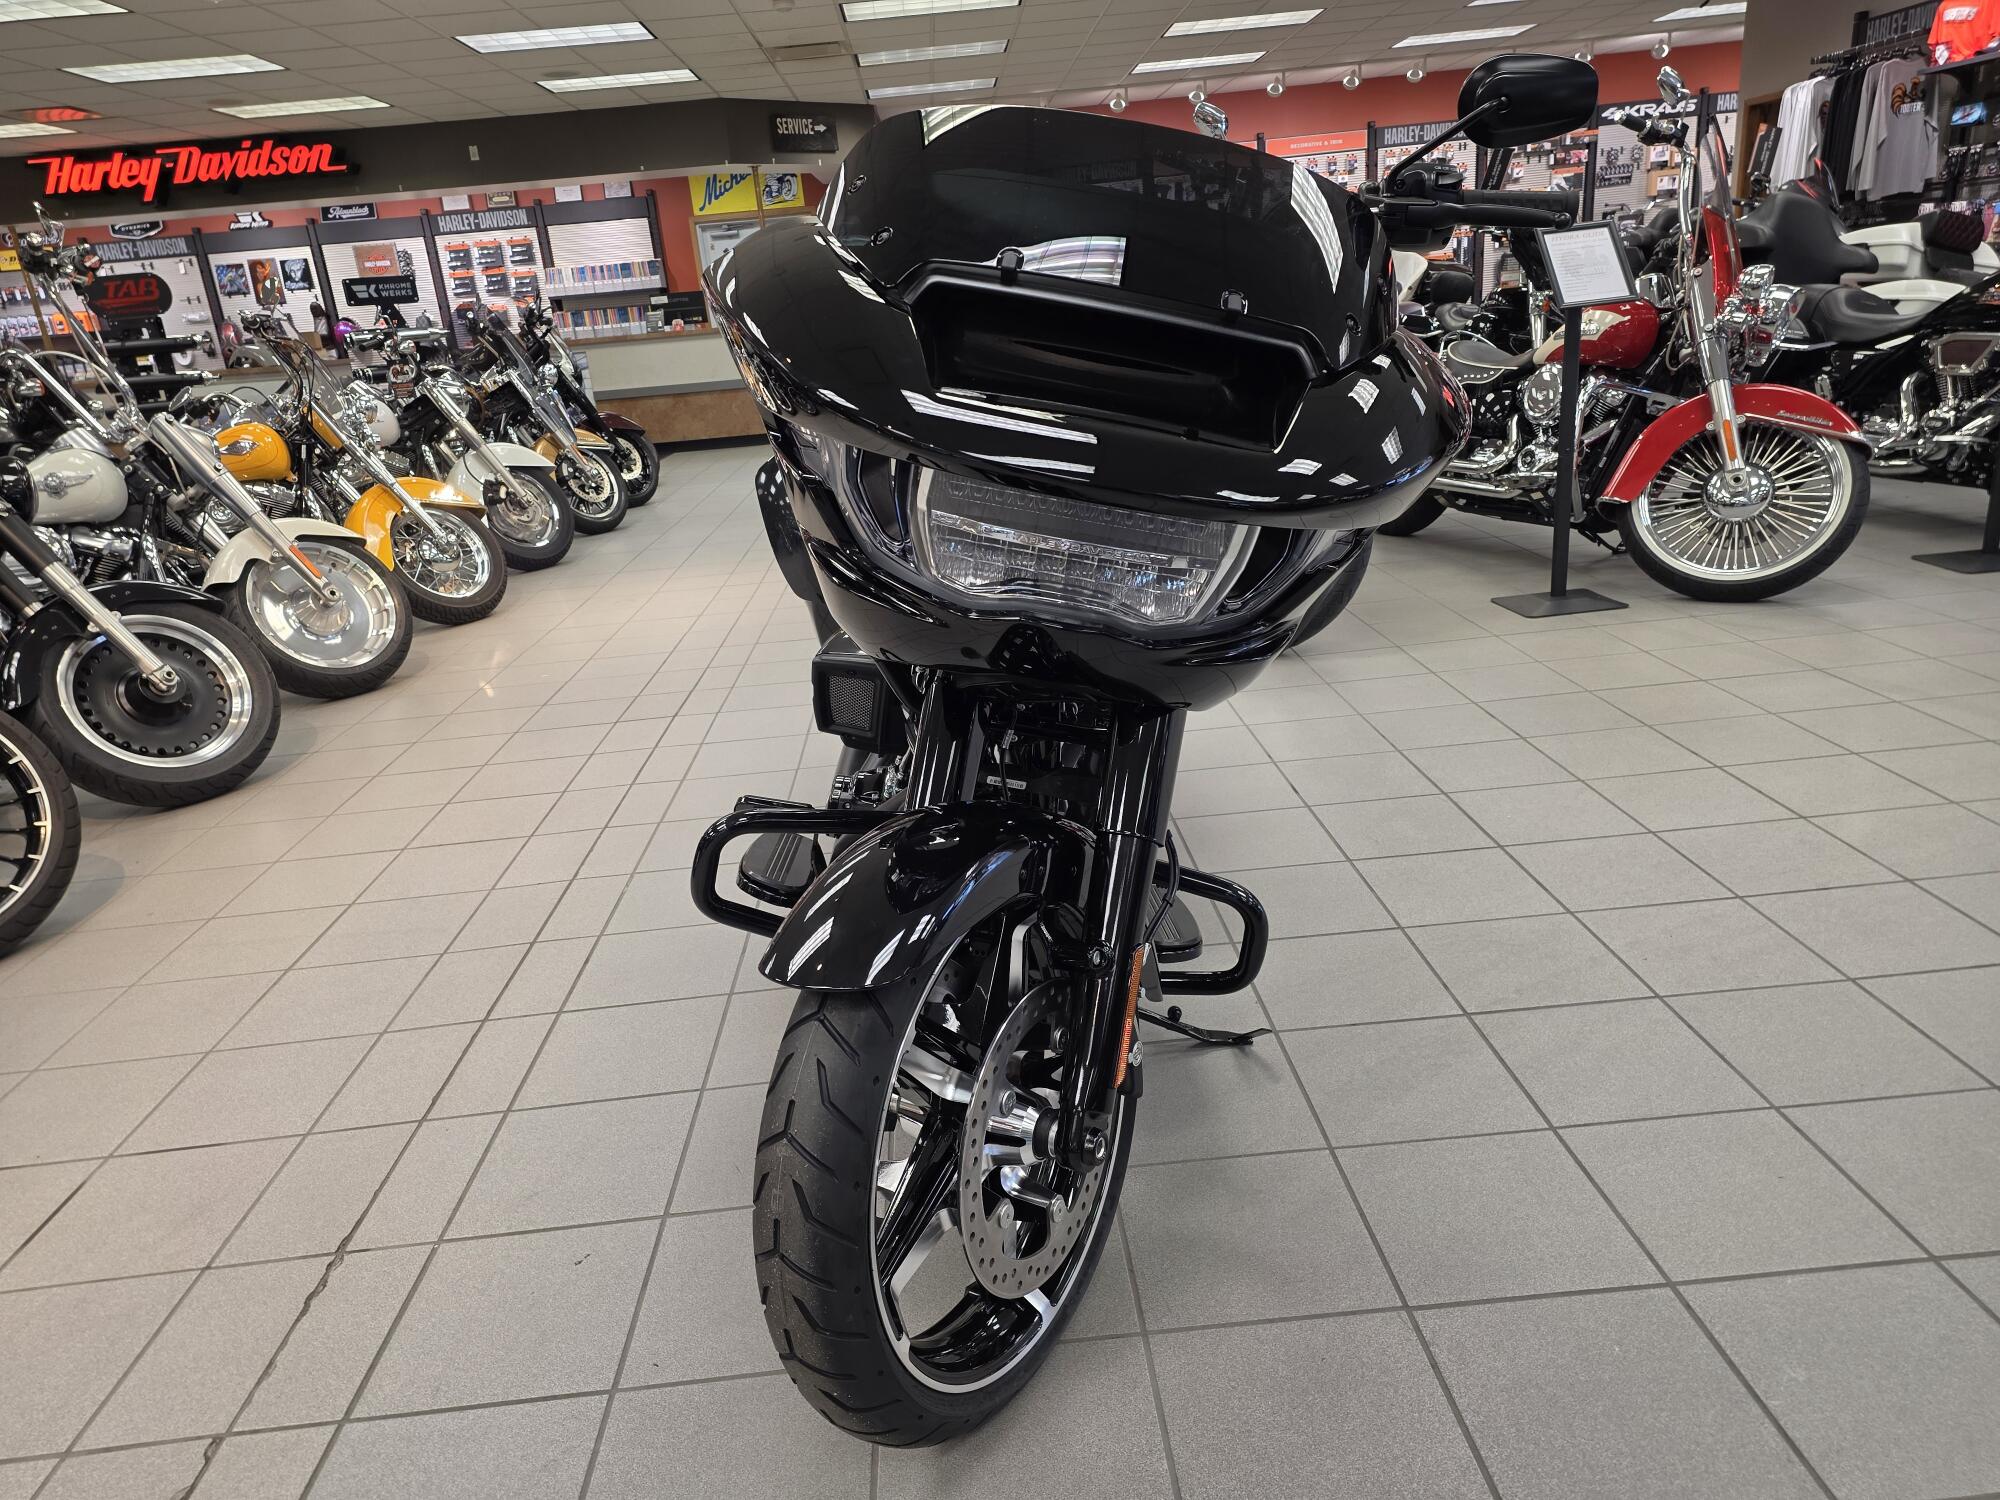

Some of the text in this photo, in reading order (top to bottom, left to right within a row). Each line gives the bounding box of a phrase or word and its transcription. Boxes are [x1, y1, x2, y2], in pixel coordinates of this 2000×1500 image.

[776, 117, 815, 135] SERVICE
[27, 140, 347, 202] Harley-Davidson
[437, 208, 528, 233] HARLEY-DAVIDSON
[96, 237, 188, 261] HARLEY-DAVIDSON
[103, 276, 160, 299] TAB
[378, 281, 412, 290] KHROME
[380, 288, 413, 297] WERKS
